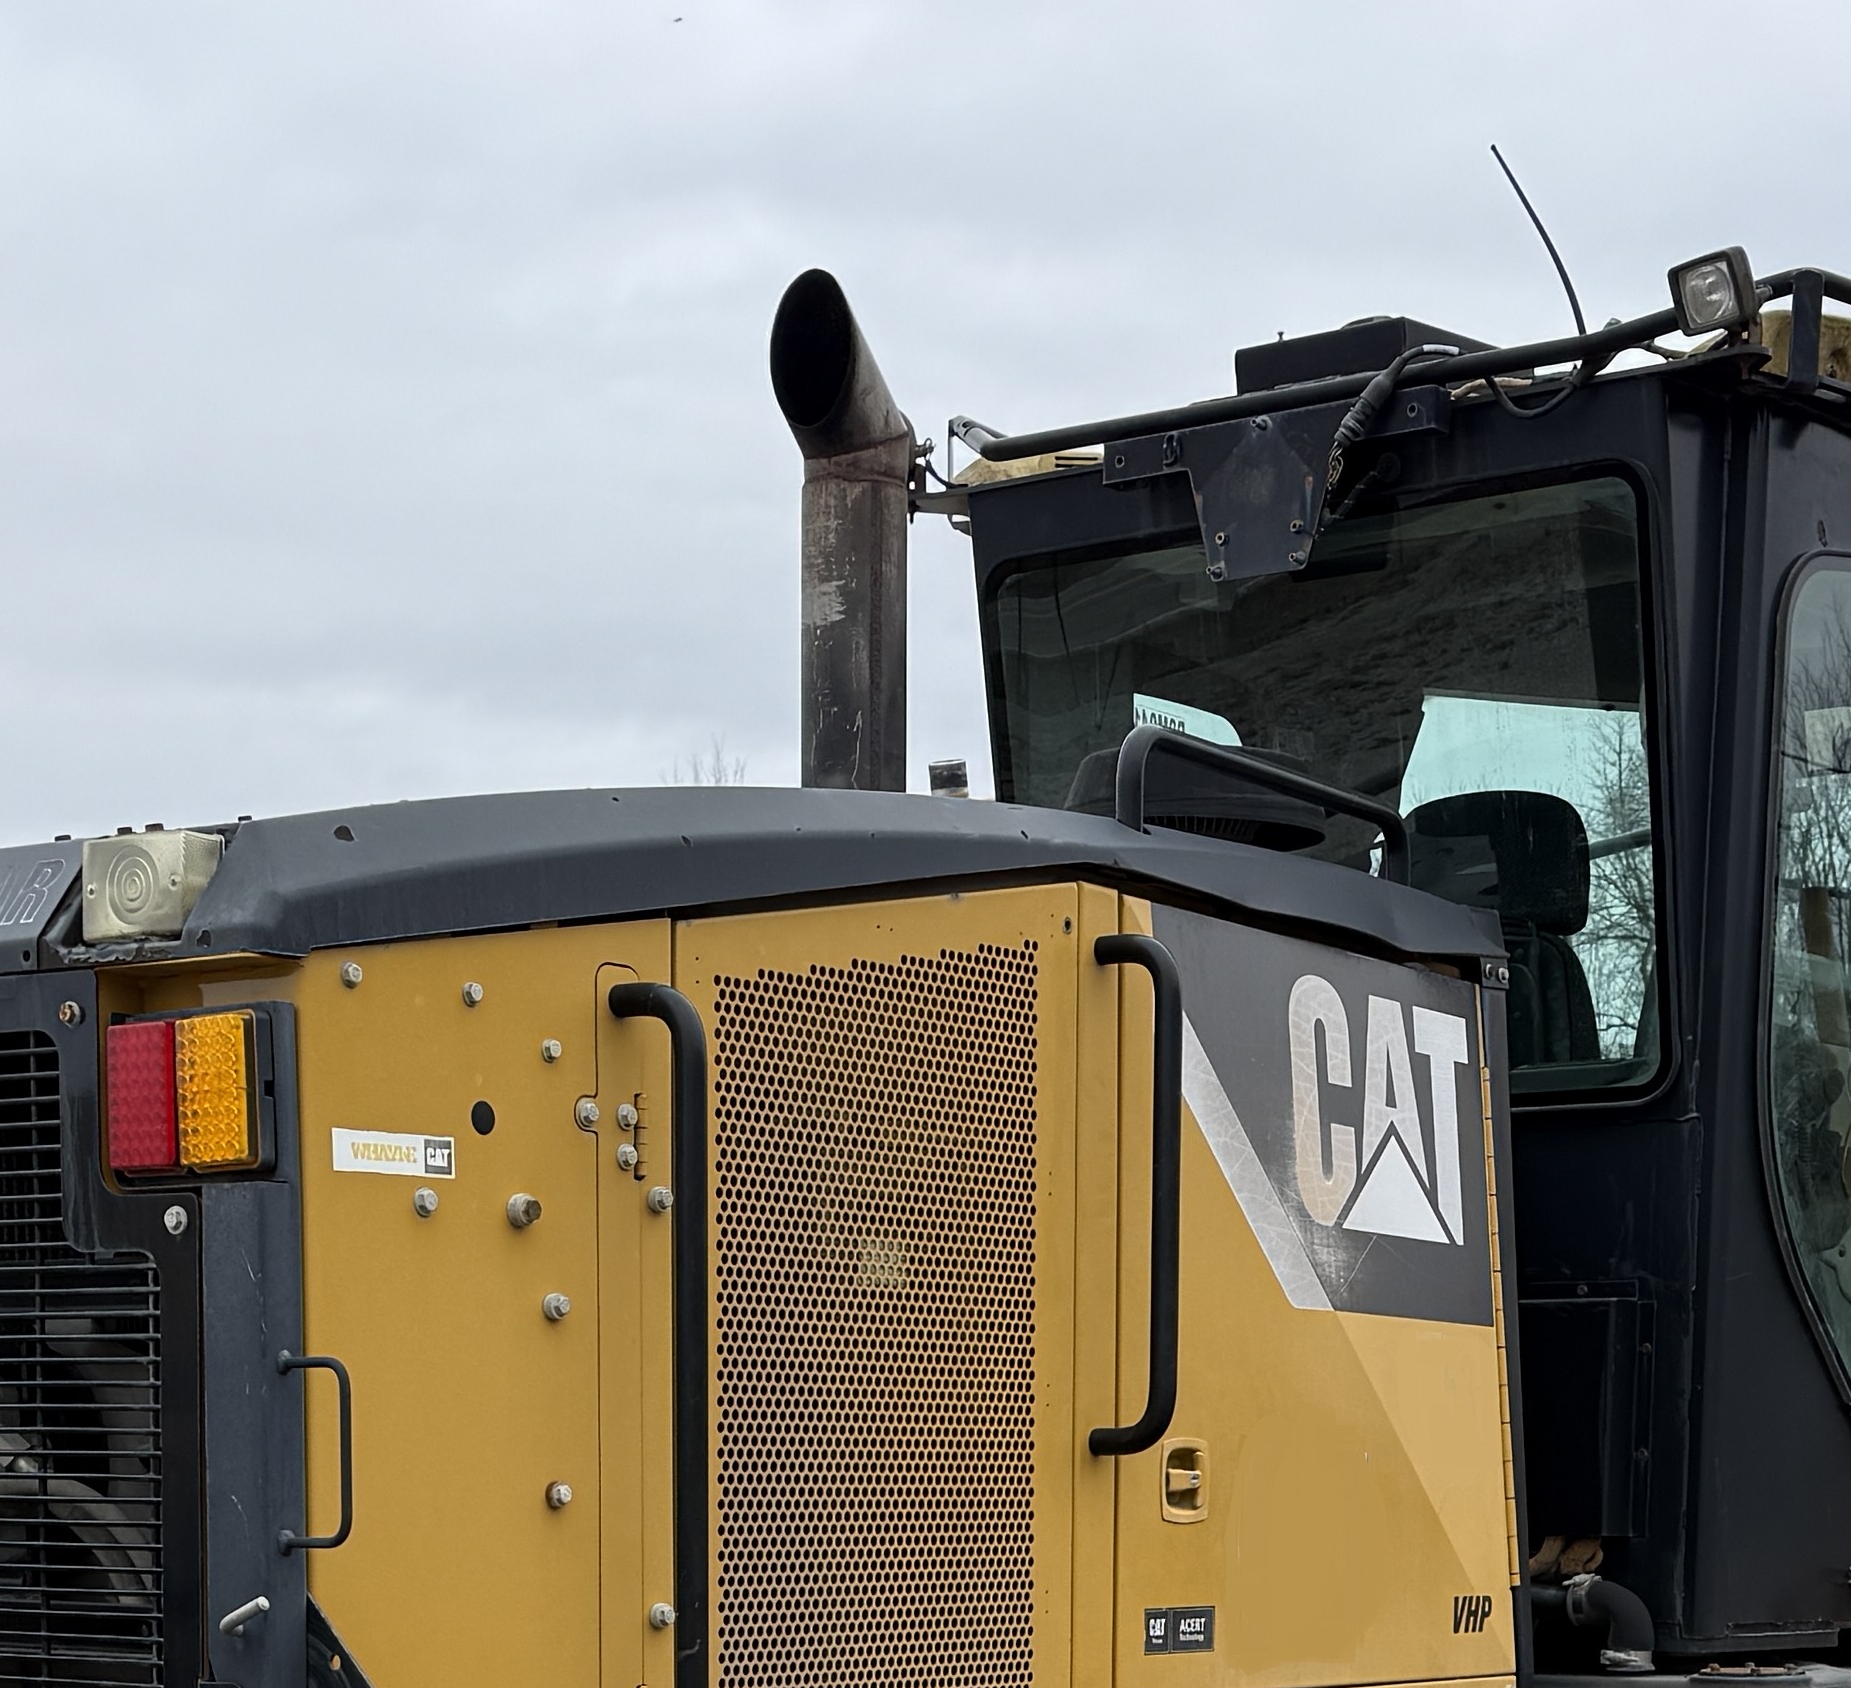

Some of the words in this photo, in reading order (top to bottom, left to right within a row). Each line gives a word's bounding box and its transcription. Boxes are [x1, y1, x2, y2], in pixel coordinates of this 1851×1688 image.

[1289, 974, 1468, 1246] CAT
[426, 1147, 450, 1167] CAT
[1453, 1595, 1492, 1634] VHP
[1149, 1618, 1165, 1636] CAT
[1179, 1618, 1206, 1632] ACERT
